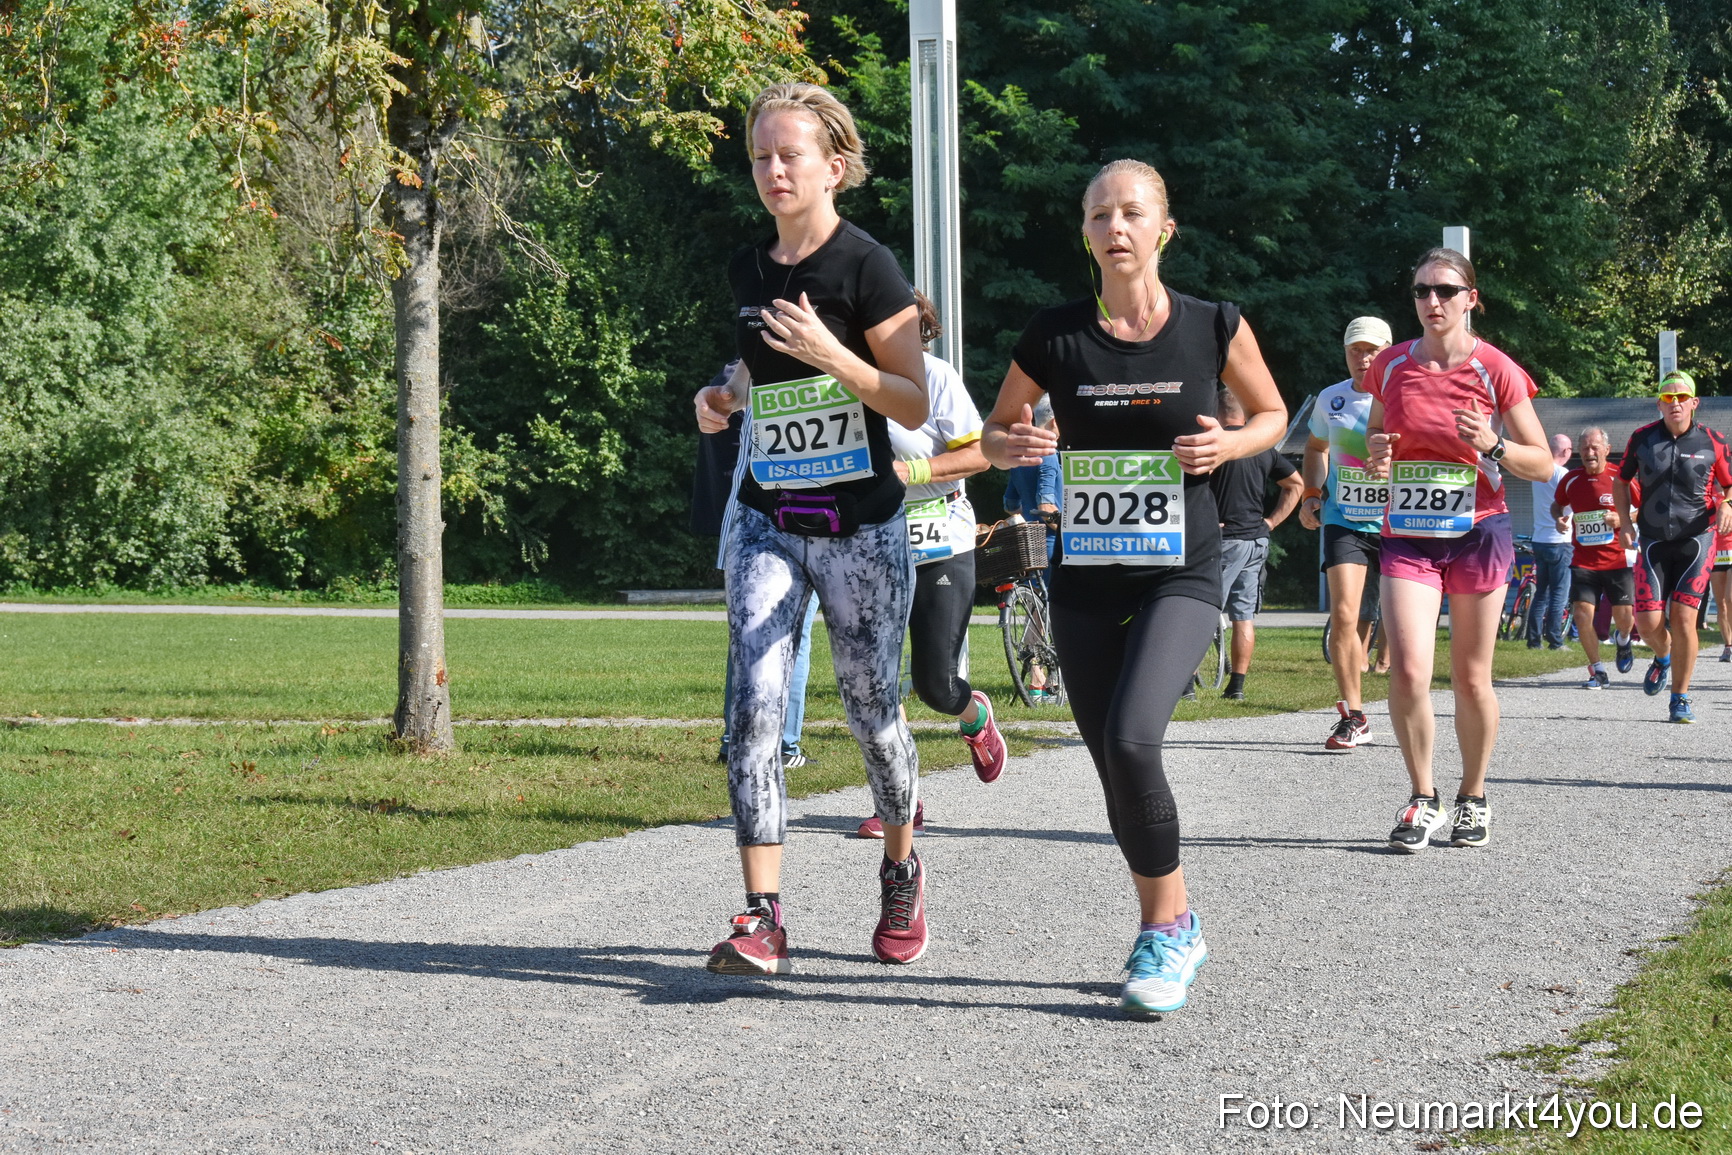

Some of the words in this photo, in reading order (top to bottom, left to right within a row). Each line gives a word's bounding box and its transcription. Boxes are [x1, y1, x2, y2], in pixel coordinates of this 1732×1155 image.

[760, 381, 847, 413] BOCK
[765, 412, 849, 455] 2027
[768, 456, 855, 479] ISABELLE
[1071, 458, 1169, 479] BOCK
[1399, 465, 1466, 483] BOCK
[1342, 485, 1389, 504] 2188
[1399, 487, 1465, 512] 2287
[1073, 491, 1169, 526] 2028
[1344, 506, 1384, 516] WERNER
[909, 522, 942, 546] 54
[1404, 517, 1455, 530] SIMONE
[1579, 522, 1608, 535] 3001
[1070, 536, 1171, 552] CHRISTINA
